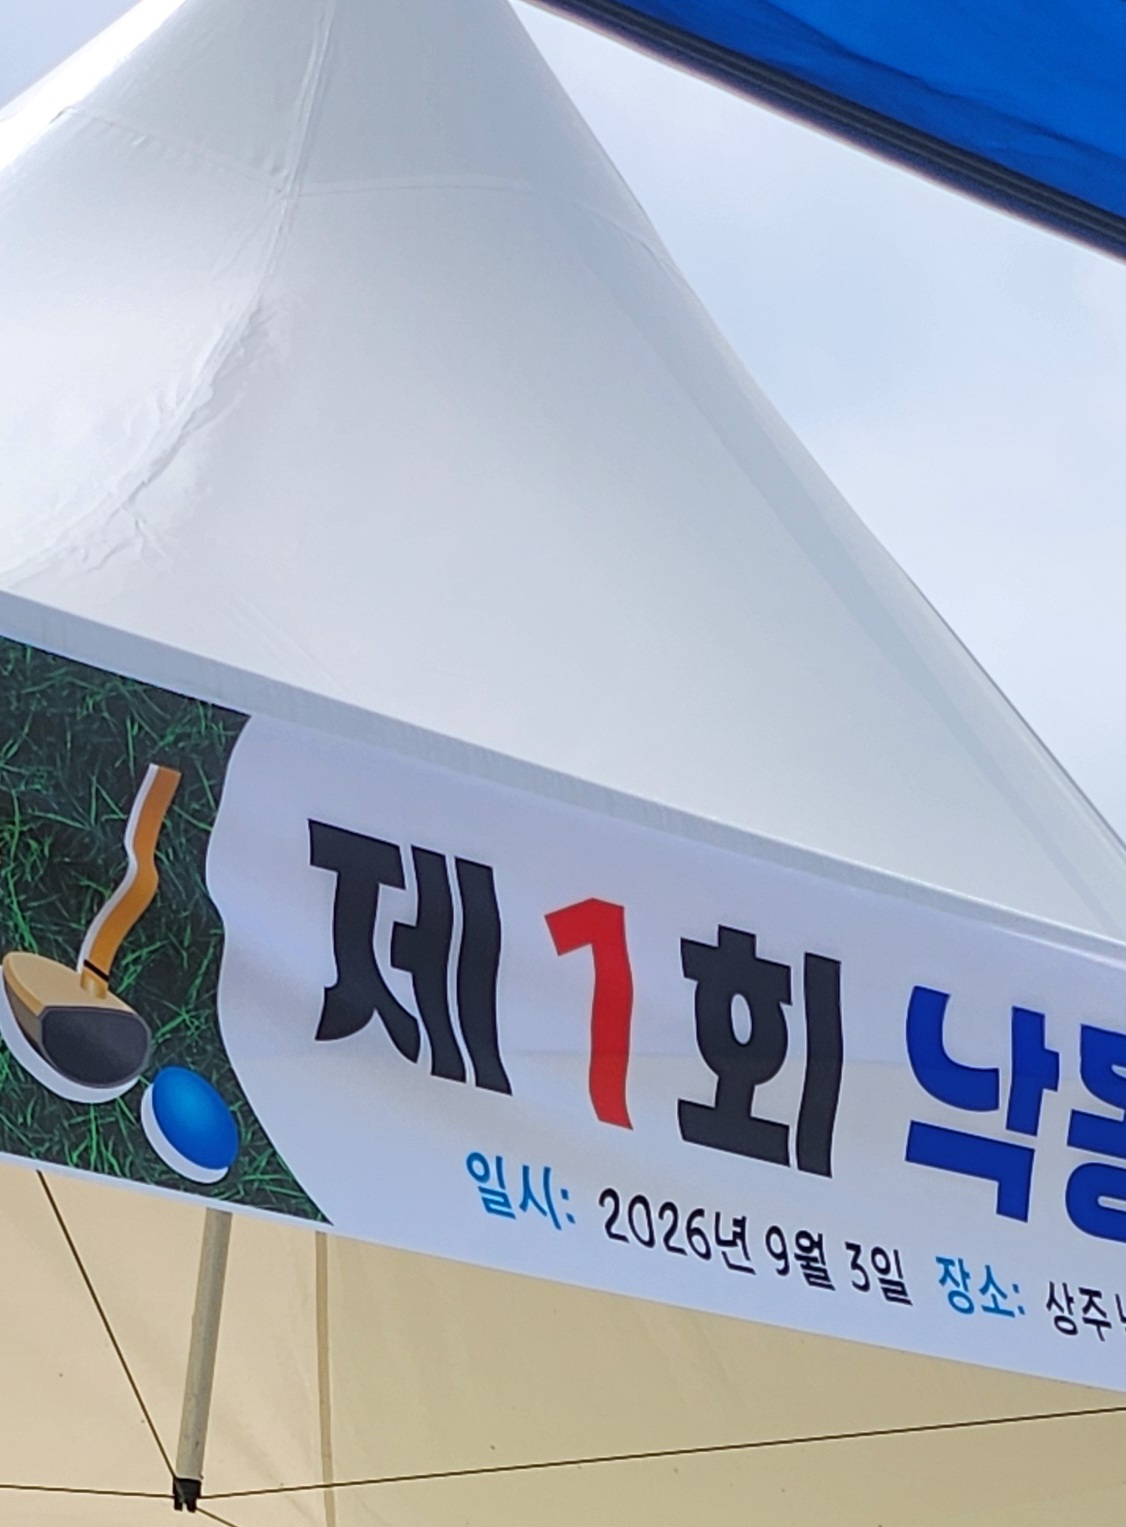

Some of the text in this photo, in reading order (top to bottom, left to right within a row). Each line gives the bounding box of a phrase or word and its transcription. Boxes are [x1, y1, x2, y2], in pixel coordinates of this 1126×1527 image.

[466, 1151, 576, 1231] 일시:
[599, 1187, 756, 1275] 2026년
[765, 1225, 836, 1292] 9월
[850, 1242, 913, 1306] 3일
[936, 1256, 1026, 1319] 장소:
